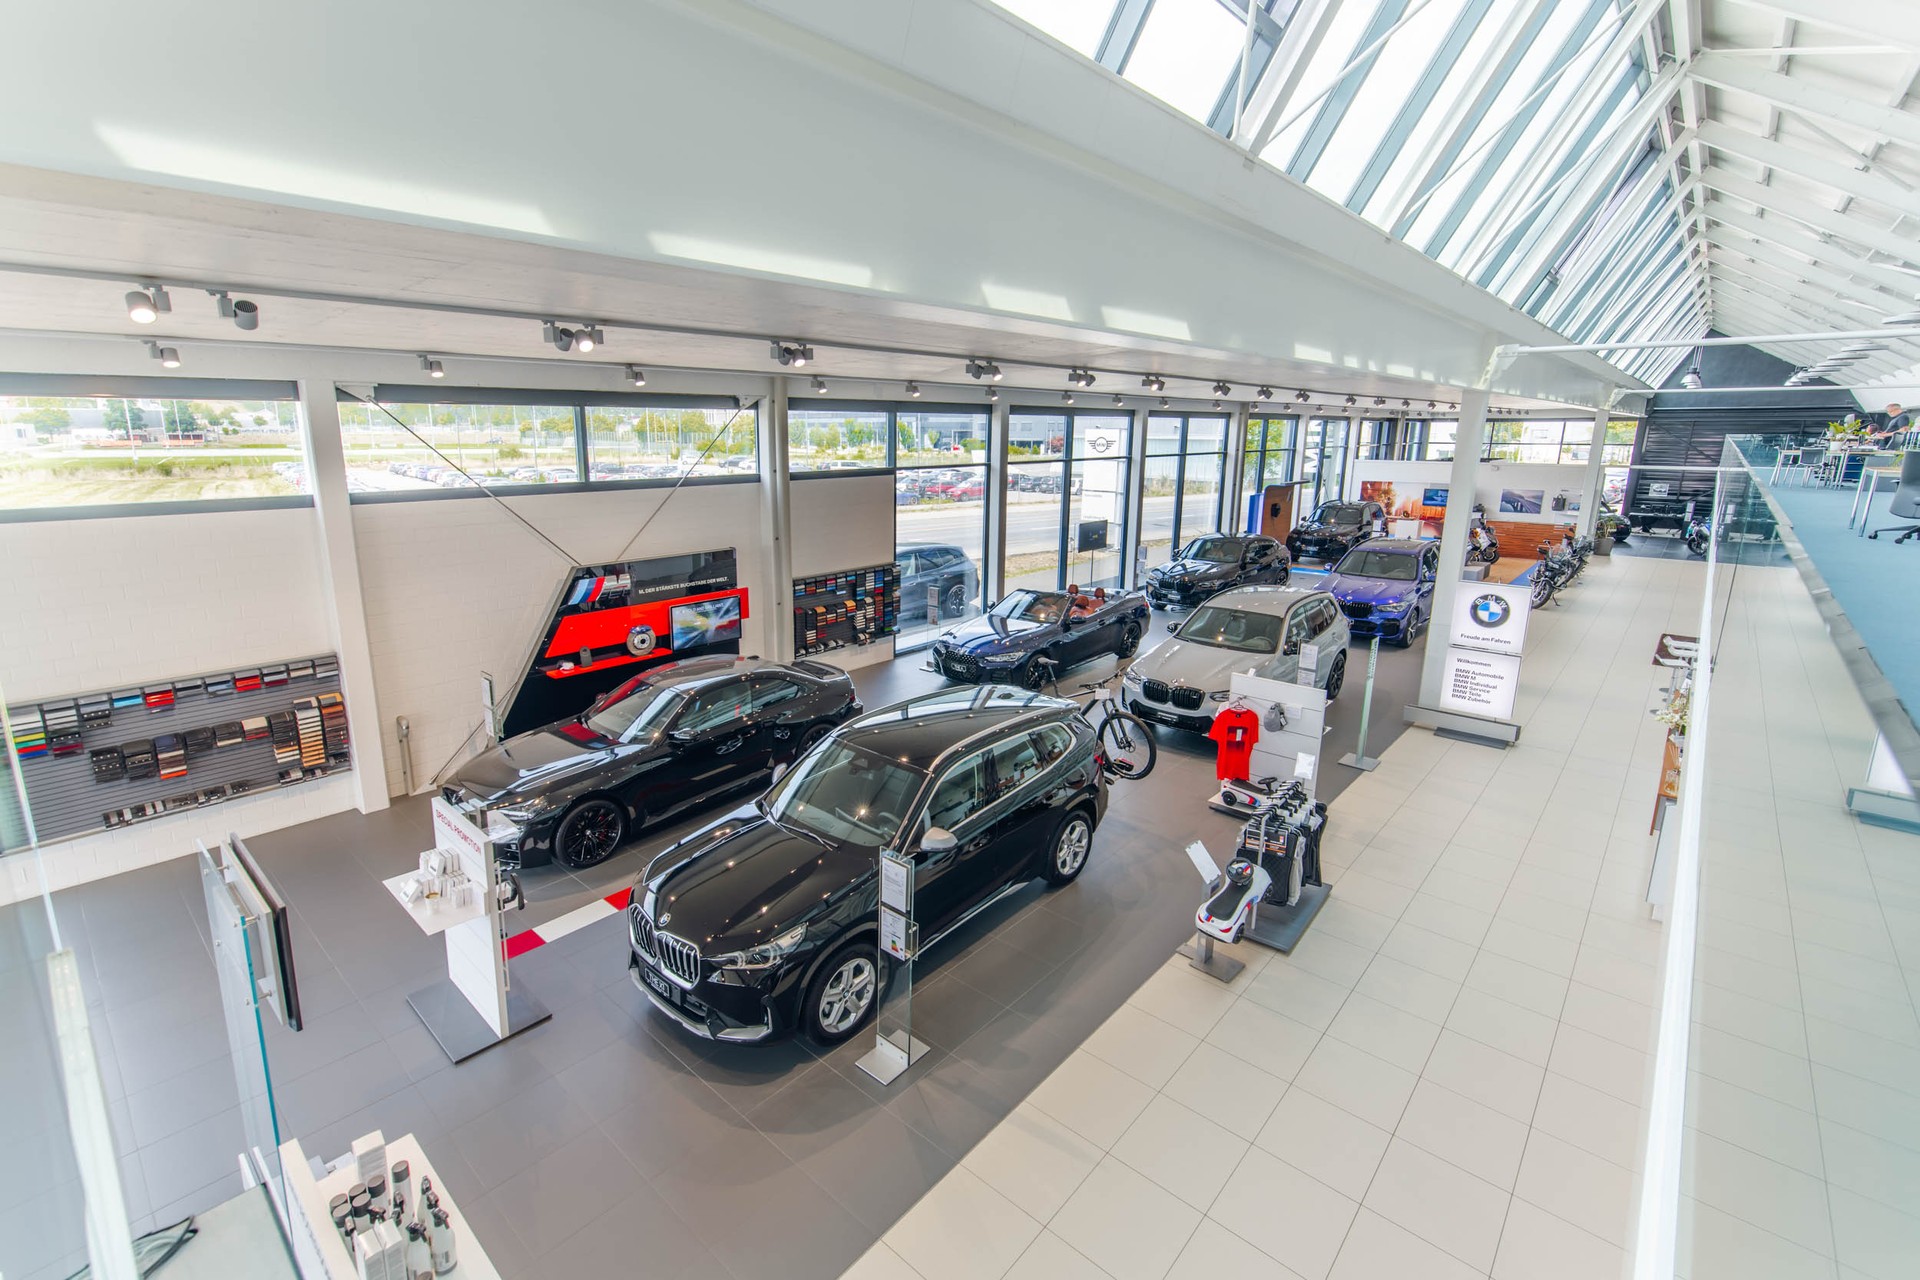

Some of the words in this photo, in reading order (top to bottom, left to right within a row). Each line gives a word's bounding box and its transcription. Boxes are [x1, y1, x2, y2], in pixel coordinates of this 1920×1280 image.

[655, 583, 680, 592] STÄRKSTE
[680, 580, 707, 588] BUCHSTABE
[1475, 595, 1508, 608] BMW
[1460, 633, 1480, 641] Freude
[1490, 637, 1511, 645] Fahren
[1456, 657, 1492, 668] Willkommen
[1471, 670, 1504, 680] Automobile
[1468, 686, 1491, 694] Service
[1469, 680, 1498, 690] Individual
[1467, 696, 1491, 704] Zubehör
[453, 824, 481, 854] PROMOTION
